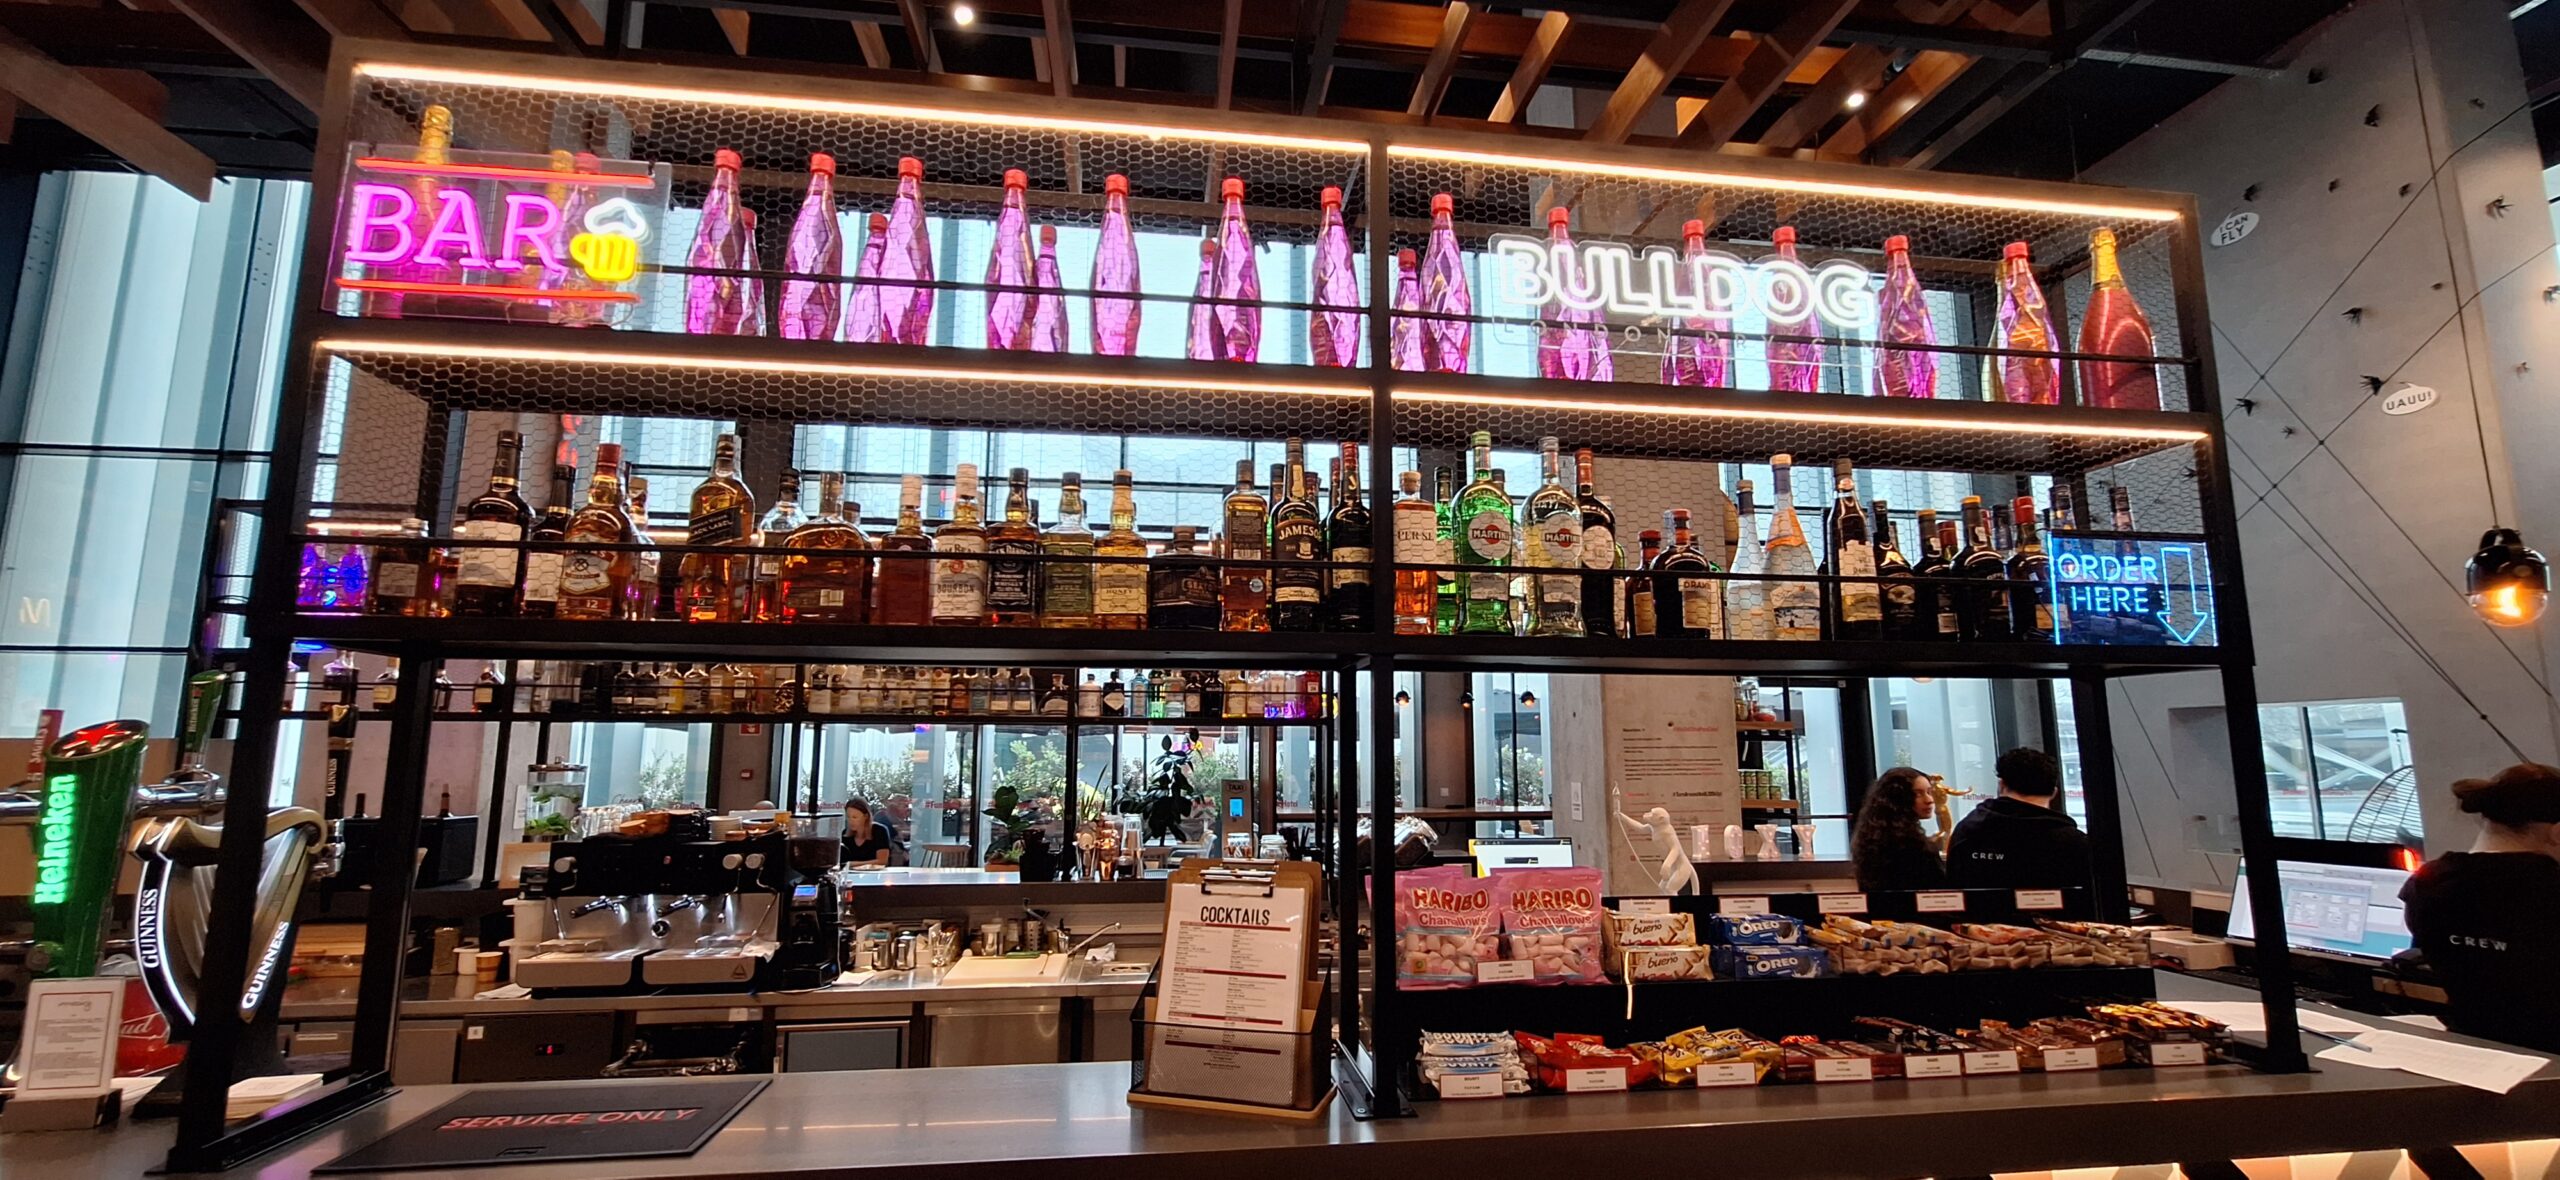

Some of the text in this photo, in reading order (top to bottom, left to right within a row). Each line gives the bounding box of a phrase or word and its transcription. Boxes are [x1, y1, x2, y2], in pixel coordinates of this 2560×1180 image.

[345, 182, 563, 273] BAR
[2225, 214, 2249, 231] CAN
[2220, 224, 2244, 244] FLY
[1497, 240, 1875, 328] BULLDOG
[1504, 318, 1675, 344] LONDON
[2386, 391, 2432, 411] UAUU!
[2057, 552, 2158, 583] ORDER
[586, 600, 598, 608] 12
[2070, 586, 2149, 613] HERE
[326, 758, 338, 797] GUINNESS
[34, 773, 76, 905] Heineken
[1971, 852, 2005, 860] CREW
[1412, 887, 1489, 912] HARIBO
[1511, 887, 1594, 912] HARIBO
[1200, 905, 1271, 926] COCKTAILS
[1419, 912, 1488, 927] Chamallows
[1519, 912, 1593, 928] Chamallows
[141, 888, 158, 968] GUINNESS
[1632, 923, 1662, 935] bueno
[1739, 920, 1780, 937] OREO
[2449, 933, 2508, 952] CREW
[240, 921, 289, 1010] GUINNESS
[1647, 956, 1679, 969] bueno
[1756, 957, 1798, 973] OREO
[121, 1012, 153, 1034] ud
[441, 1109, 698, 1129] SERVICE ONLY
